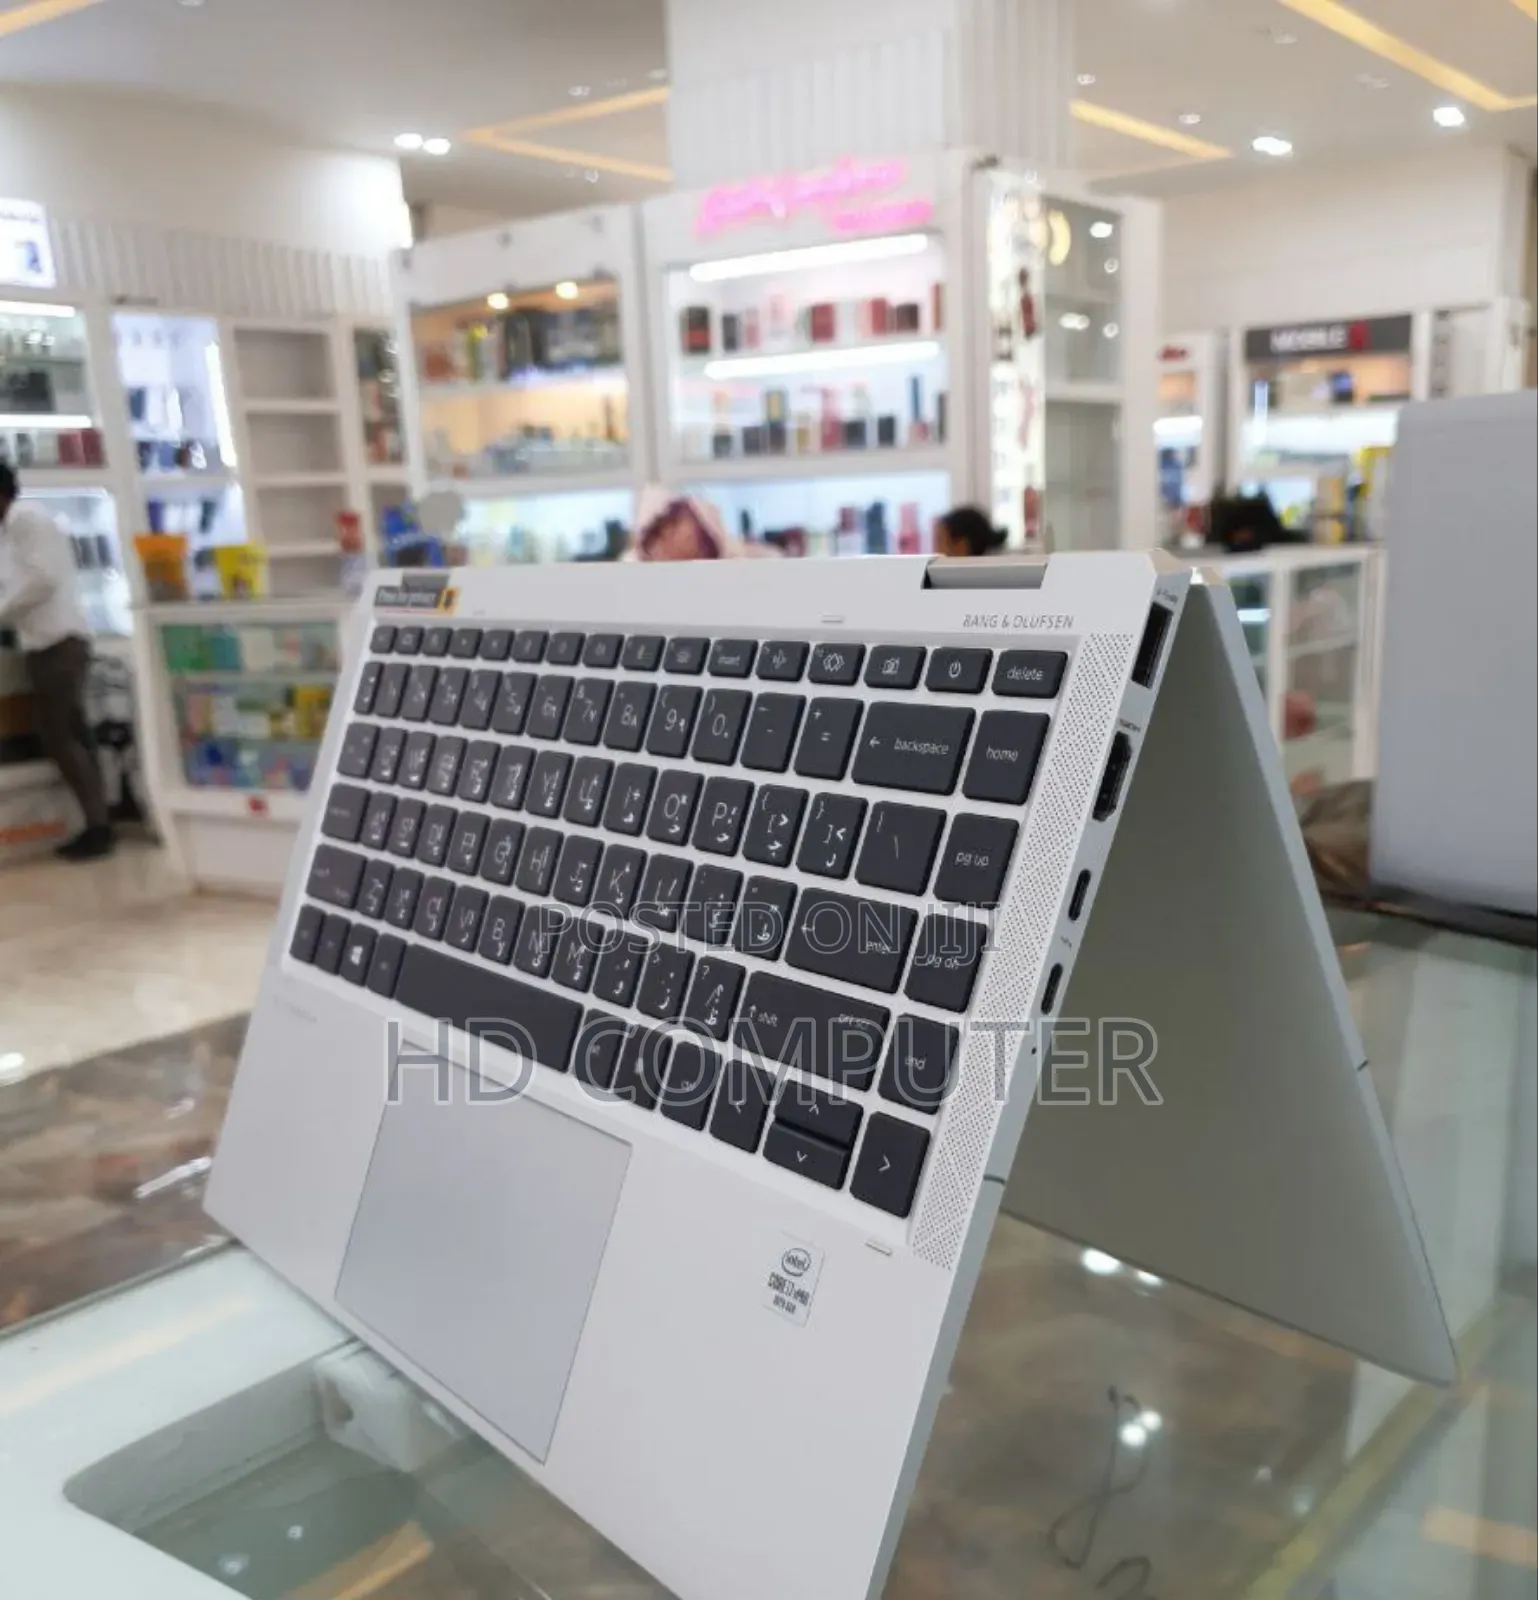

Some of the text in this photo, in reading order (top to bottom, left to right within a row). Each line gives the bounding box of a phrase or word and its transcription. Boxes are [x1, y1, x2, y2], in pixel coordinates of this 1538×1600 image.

[963, 614, 998, 628] BANG
[1013, 615, 1074, 630] OLUFSEN
[1007, 666, 1044, 682] delete
[894, 738, 949, 755] backspace
[986, 746, 1019, 763] home
[955, 852, 989, 869] pg up
[904, 1055, 927, 1071] end
